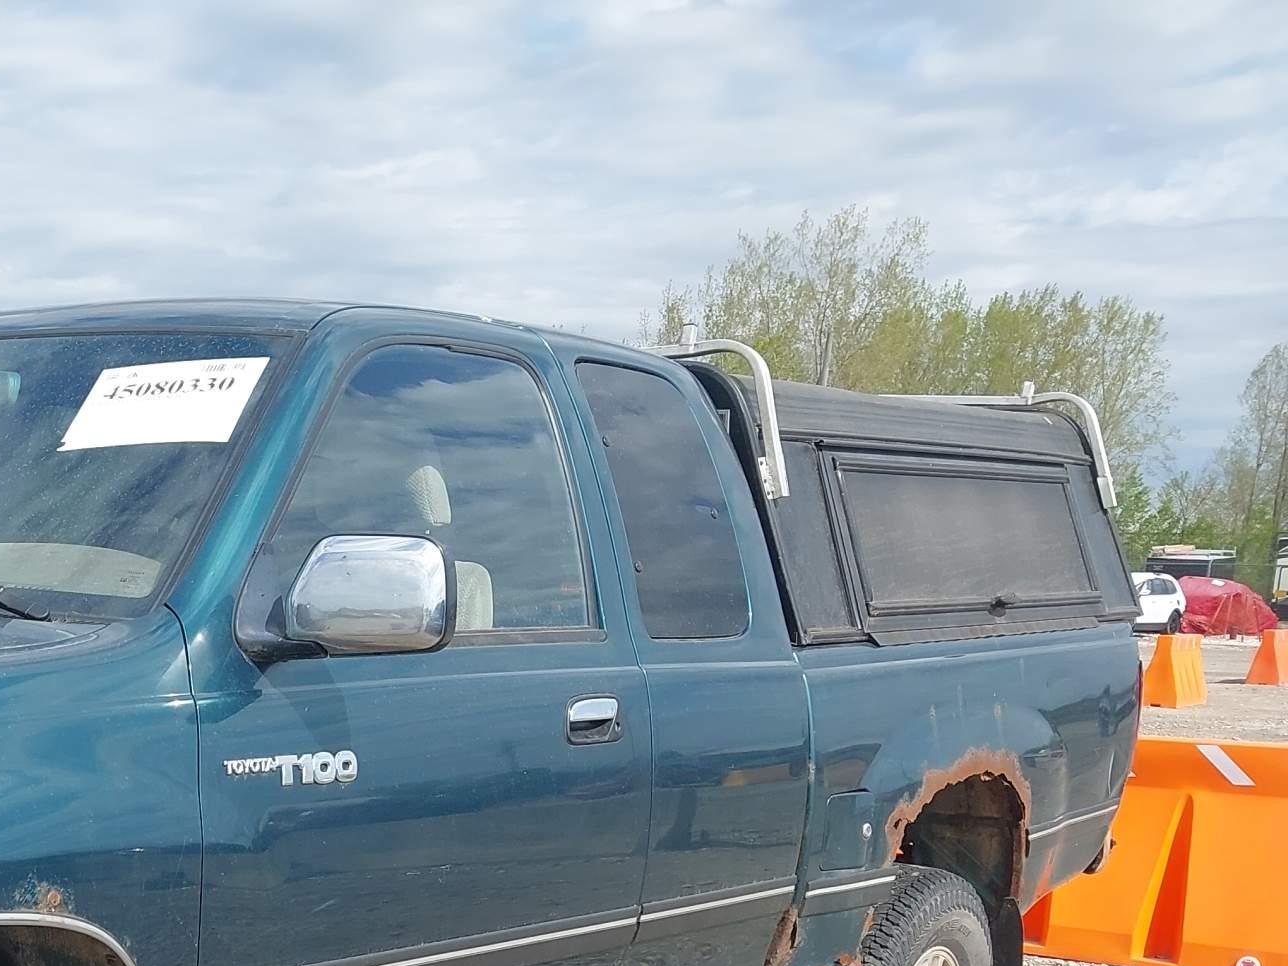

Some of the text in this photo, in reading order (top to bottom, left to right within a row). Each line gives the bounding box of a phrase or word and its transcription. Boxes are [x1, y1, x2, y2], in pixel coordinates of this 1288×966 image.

[104, 376, 235, 399] 45080330
[224, 750, 358, 786] TOYOTA T100
